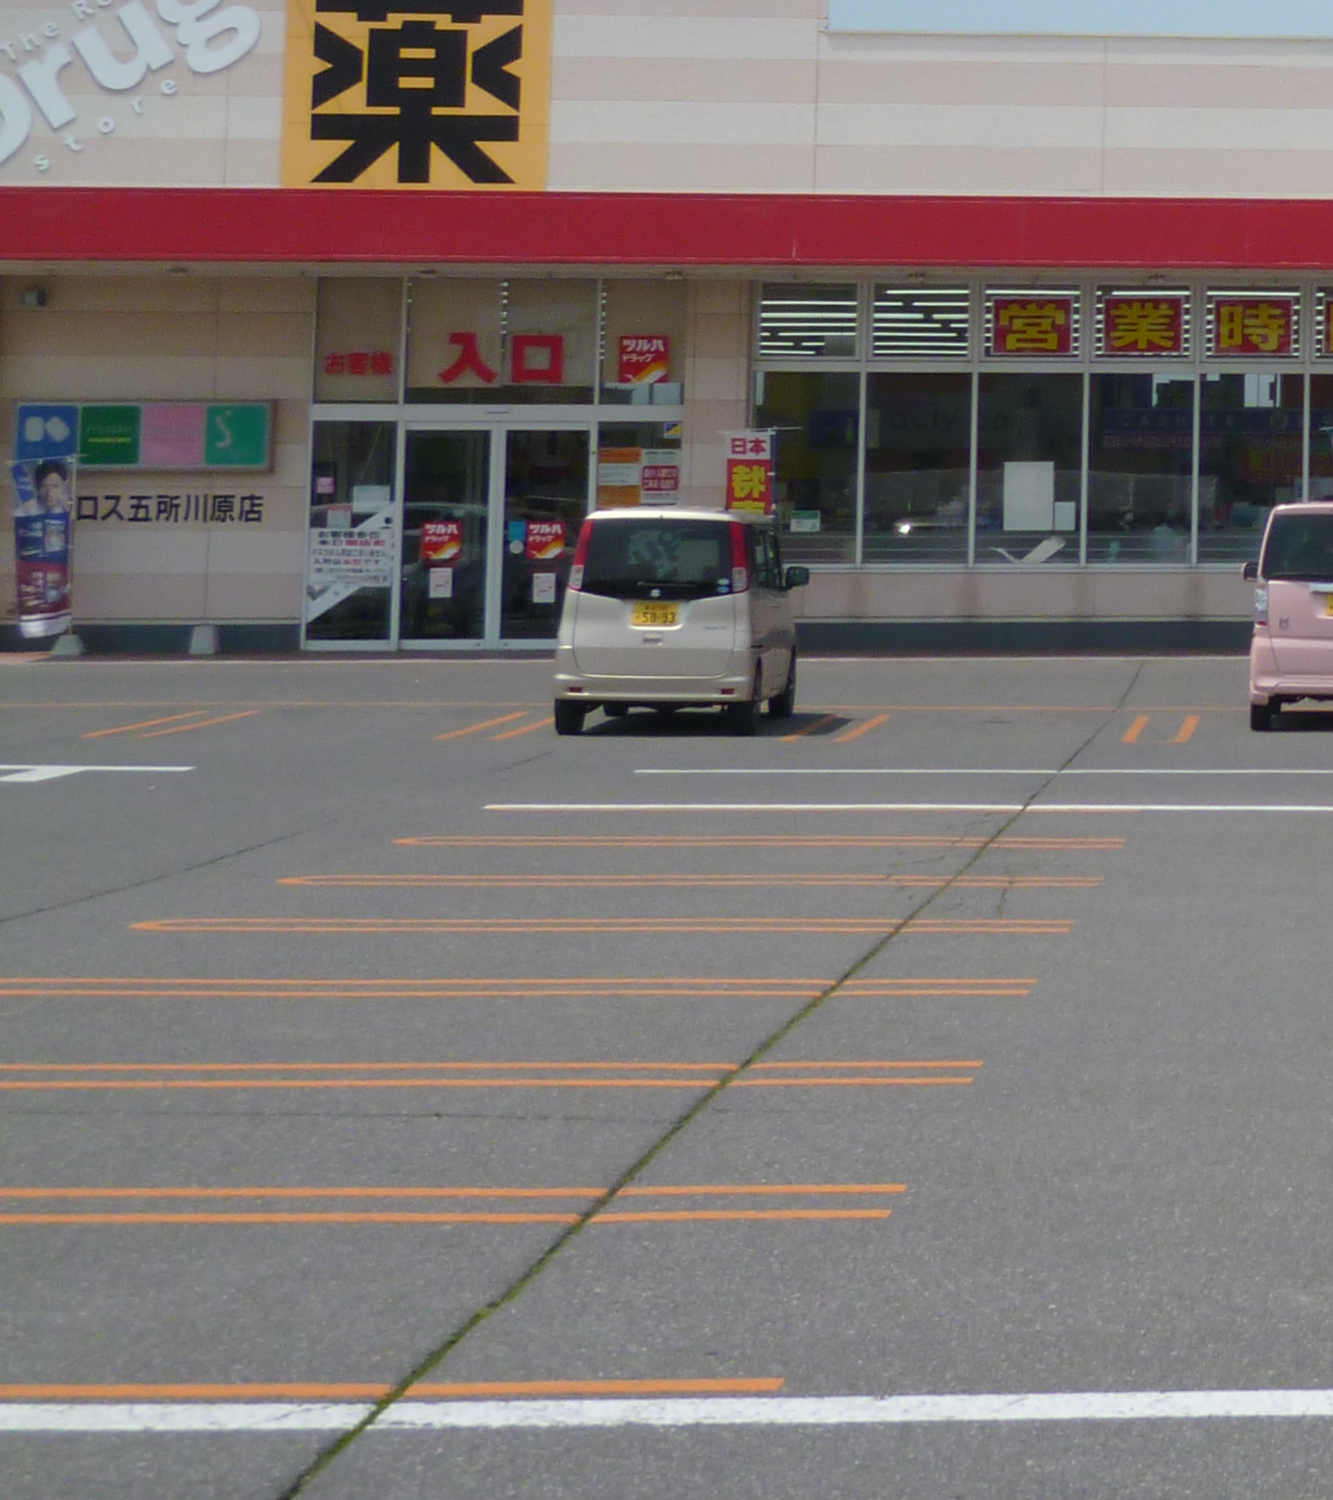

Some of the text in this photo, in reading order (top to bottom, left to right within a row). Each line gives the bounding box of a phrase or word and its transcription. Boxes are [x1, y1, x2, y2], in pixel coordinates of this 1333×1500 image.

[0, 21, 60, 62] The
[34, 78, 179, 172] store
[622, 338, 666, 353] ツルハ
[438, 331, 564, 385] 入口
[1119, 413, 1236, 428] CASHER
[425, 523, 458, 534] ツルハ
[529, 523, 562, 534] ツルハ
